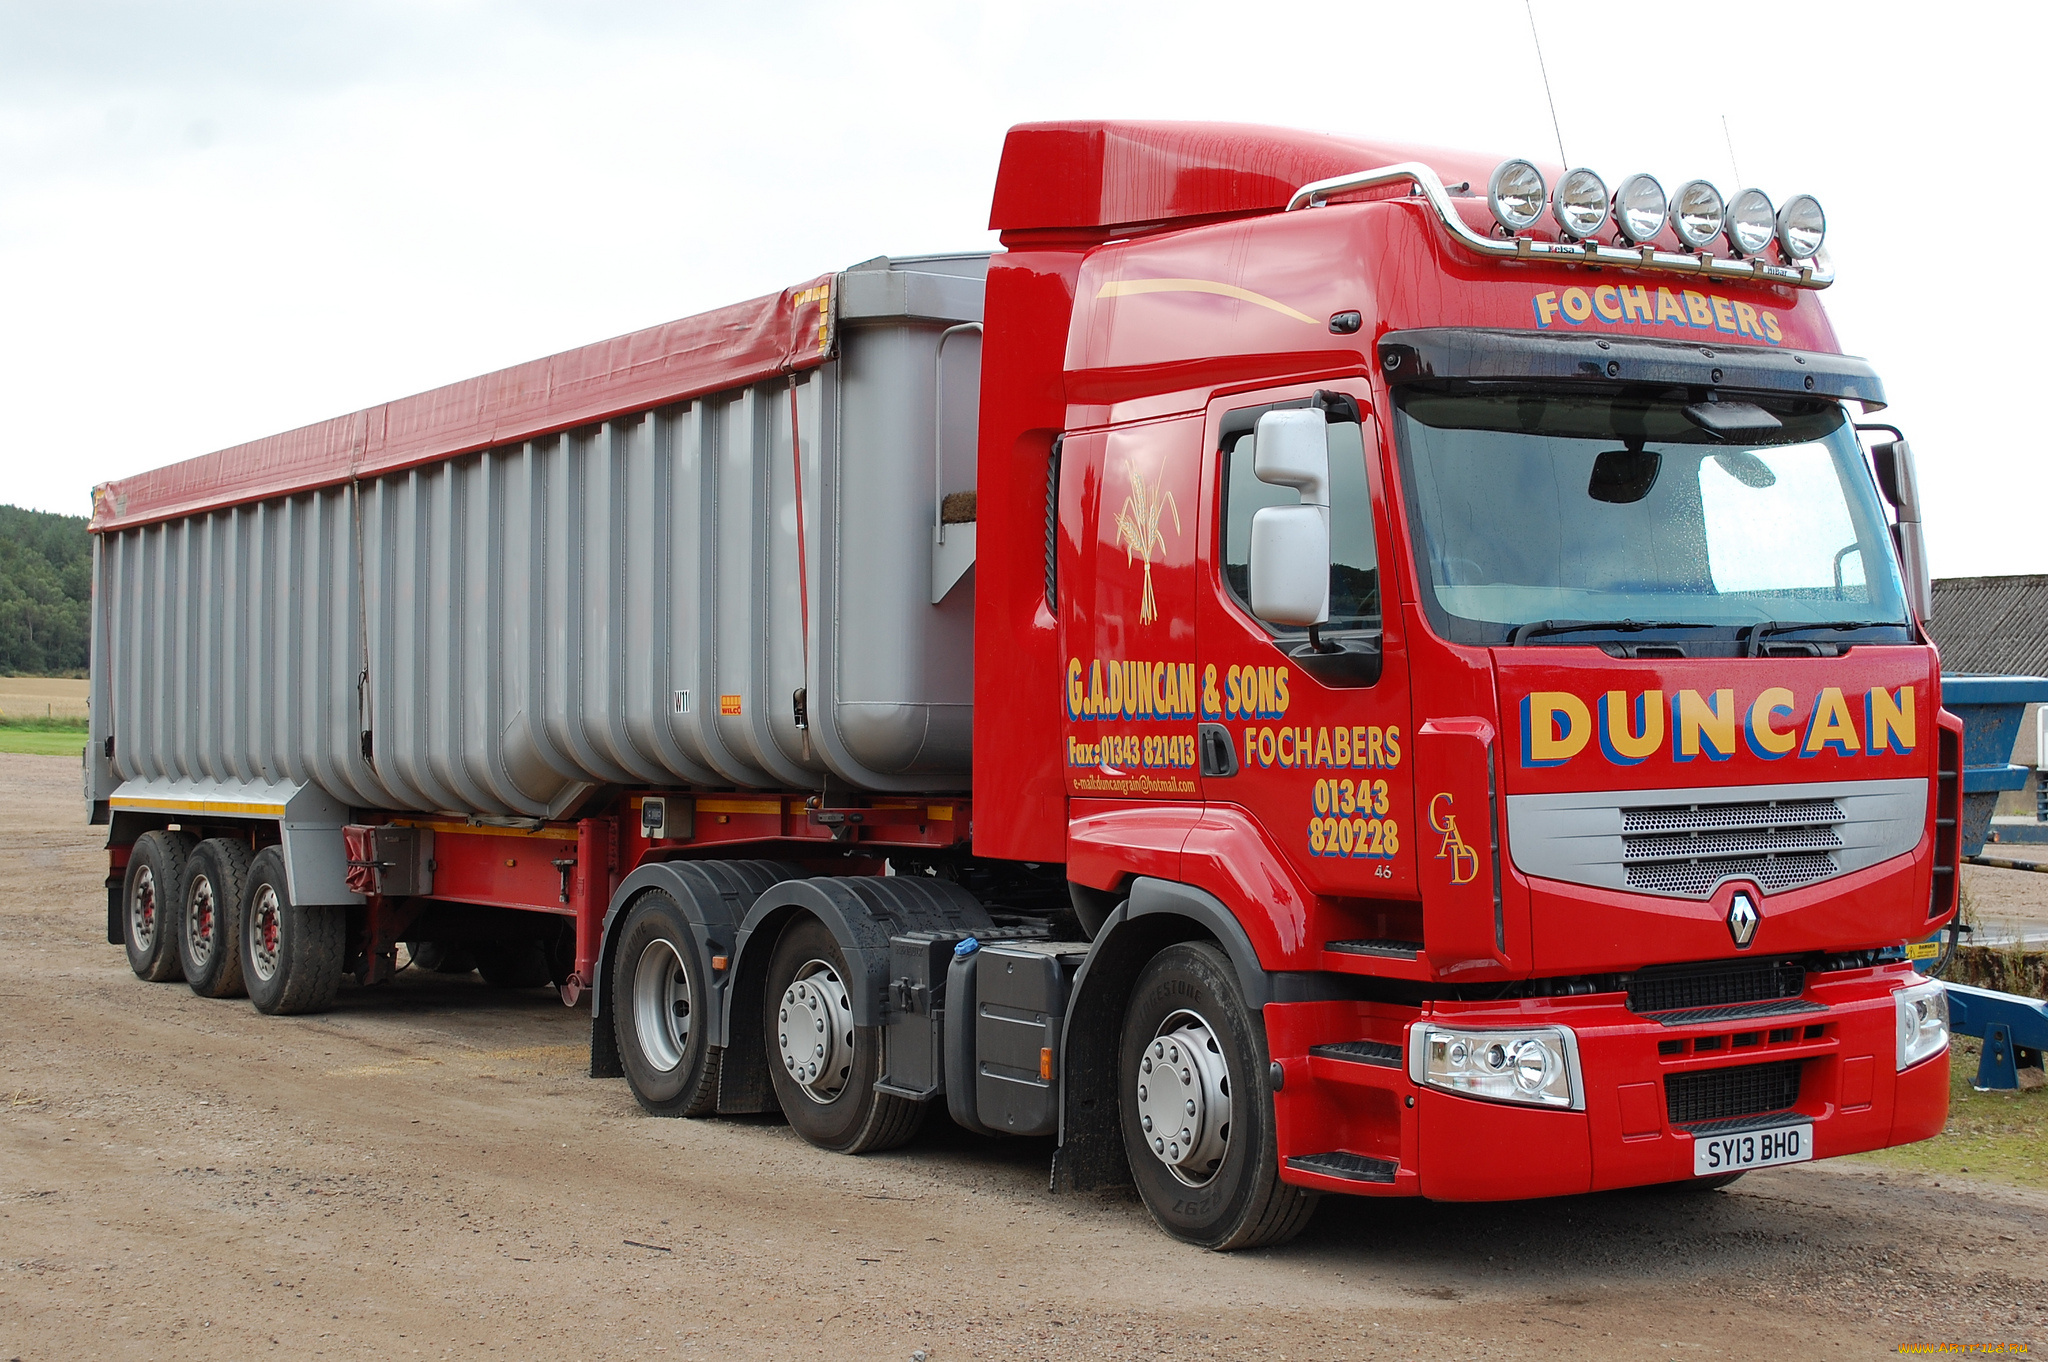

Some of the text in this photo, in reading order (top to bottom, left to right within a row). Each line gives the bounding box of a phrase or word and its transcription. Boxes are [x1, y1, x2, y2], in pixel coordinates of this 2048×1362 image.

[1533, 285, 1783, 345] FOCHABERS
[1066, 657, 1290, 721] G.A.DUNCAN & SONS
[1244, 725, 1401, 770] FOCHABERS
[1520, 687, 1916, 768] DUNCAN
[1141, 735, 1196, 769] 821413
[1312, 778, 1390, 820] 01343
[1307, 817, 1400, 860] 820228
[1374, 864, 1393, 879] 46
[1708, 1130, 1800, 1168] SY13 BHO
